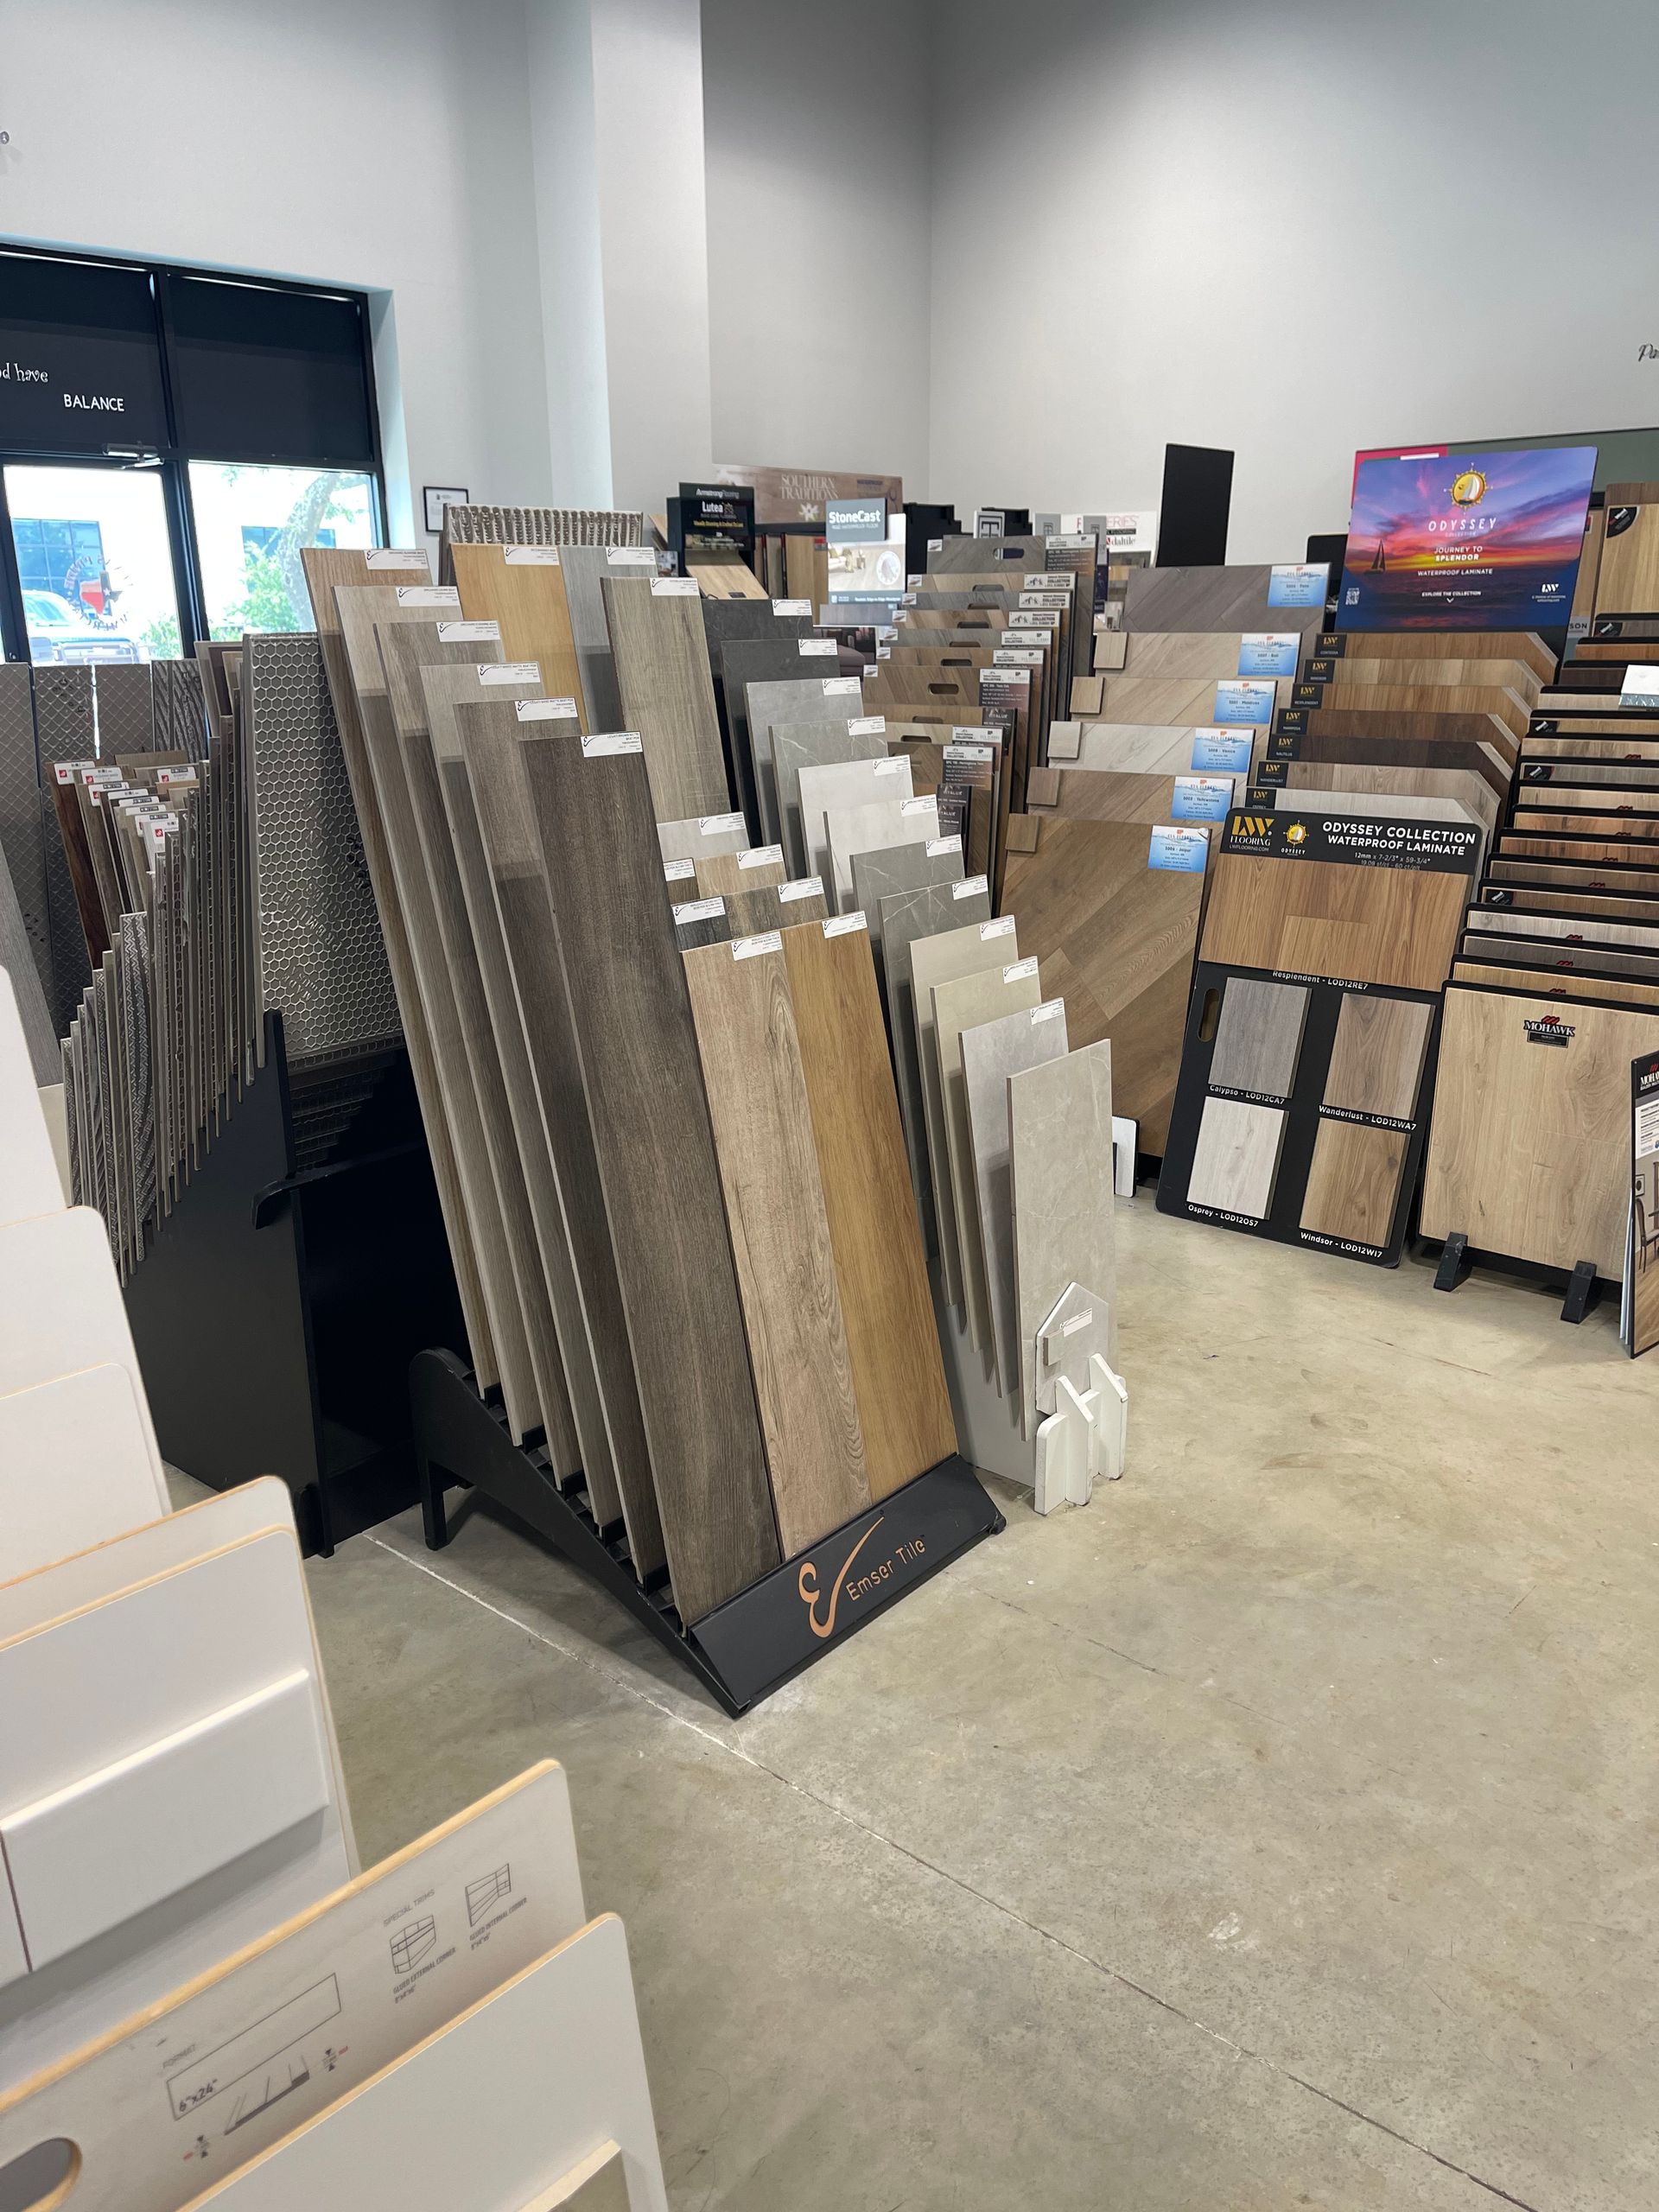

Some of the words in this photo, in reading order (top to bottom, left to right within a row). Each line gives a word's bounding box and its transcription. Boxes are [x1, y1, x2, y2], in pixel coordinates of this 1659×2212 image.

[14, 363, 48, 383] have
[63, 393, 125, 412] BALANCE
[781, 474, 836, 489] SOUTHERN
[780, 486, 839, 499] TRADITIONS
[702, 500, 723, 513] Lutea
[829, 509, 881, 524] StoneCast
[1428, 518, 1497, 532] ODYSSEY
[1111, 536, 1135, 546] daltile
[1230, 836, 1271, 847] FLOORING
[1322, 821, 1382, 836] ODYSSEY
[1387, 826, 1476, 844] COLLECTION
[1327, 835, 1404, 850] WATERPROOF
[1406, 842, 1465, 856] LAMINATE
[1272, 970, 1320, 984] Resplendent
[1327, 978, 1369, 990] LOD12RE7
[1525, 1020, 1574, 1036] MOHAWK
[1210, 1084, 1238, 1096] Calypso
[1245, 1091, 1286, 1105] LOD12CA7
[1319, 1105, 1363, 1121] Wanderlust
[1370, 1116, 1417, 1131] LOD12WA7
[1188, 1205, 1214, 1217] Osprey
[1300, 1231, 1333, 1246] Windsor
[1340, 1242, 1383, 1258] LOD12WI7
[845, 1560, 894, 1601] Emser
[895, 1539, 926, 1565] Tile
[383, 1904, 413, 1928] SPECIAL
[393, 1979, 410, 1994] GLUED
[410, 1961, 435, 1983] EXTERNAL
[435, 1946, 456, 1966] CORNER
